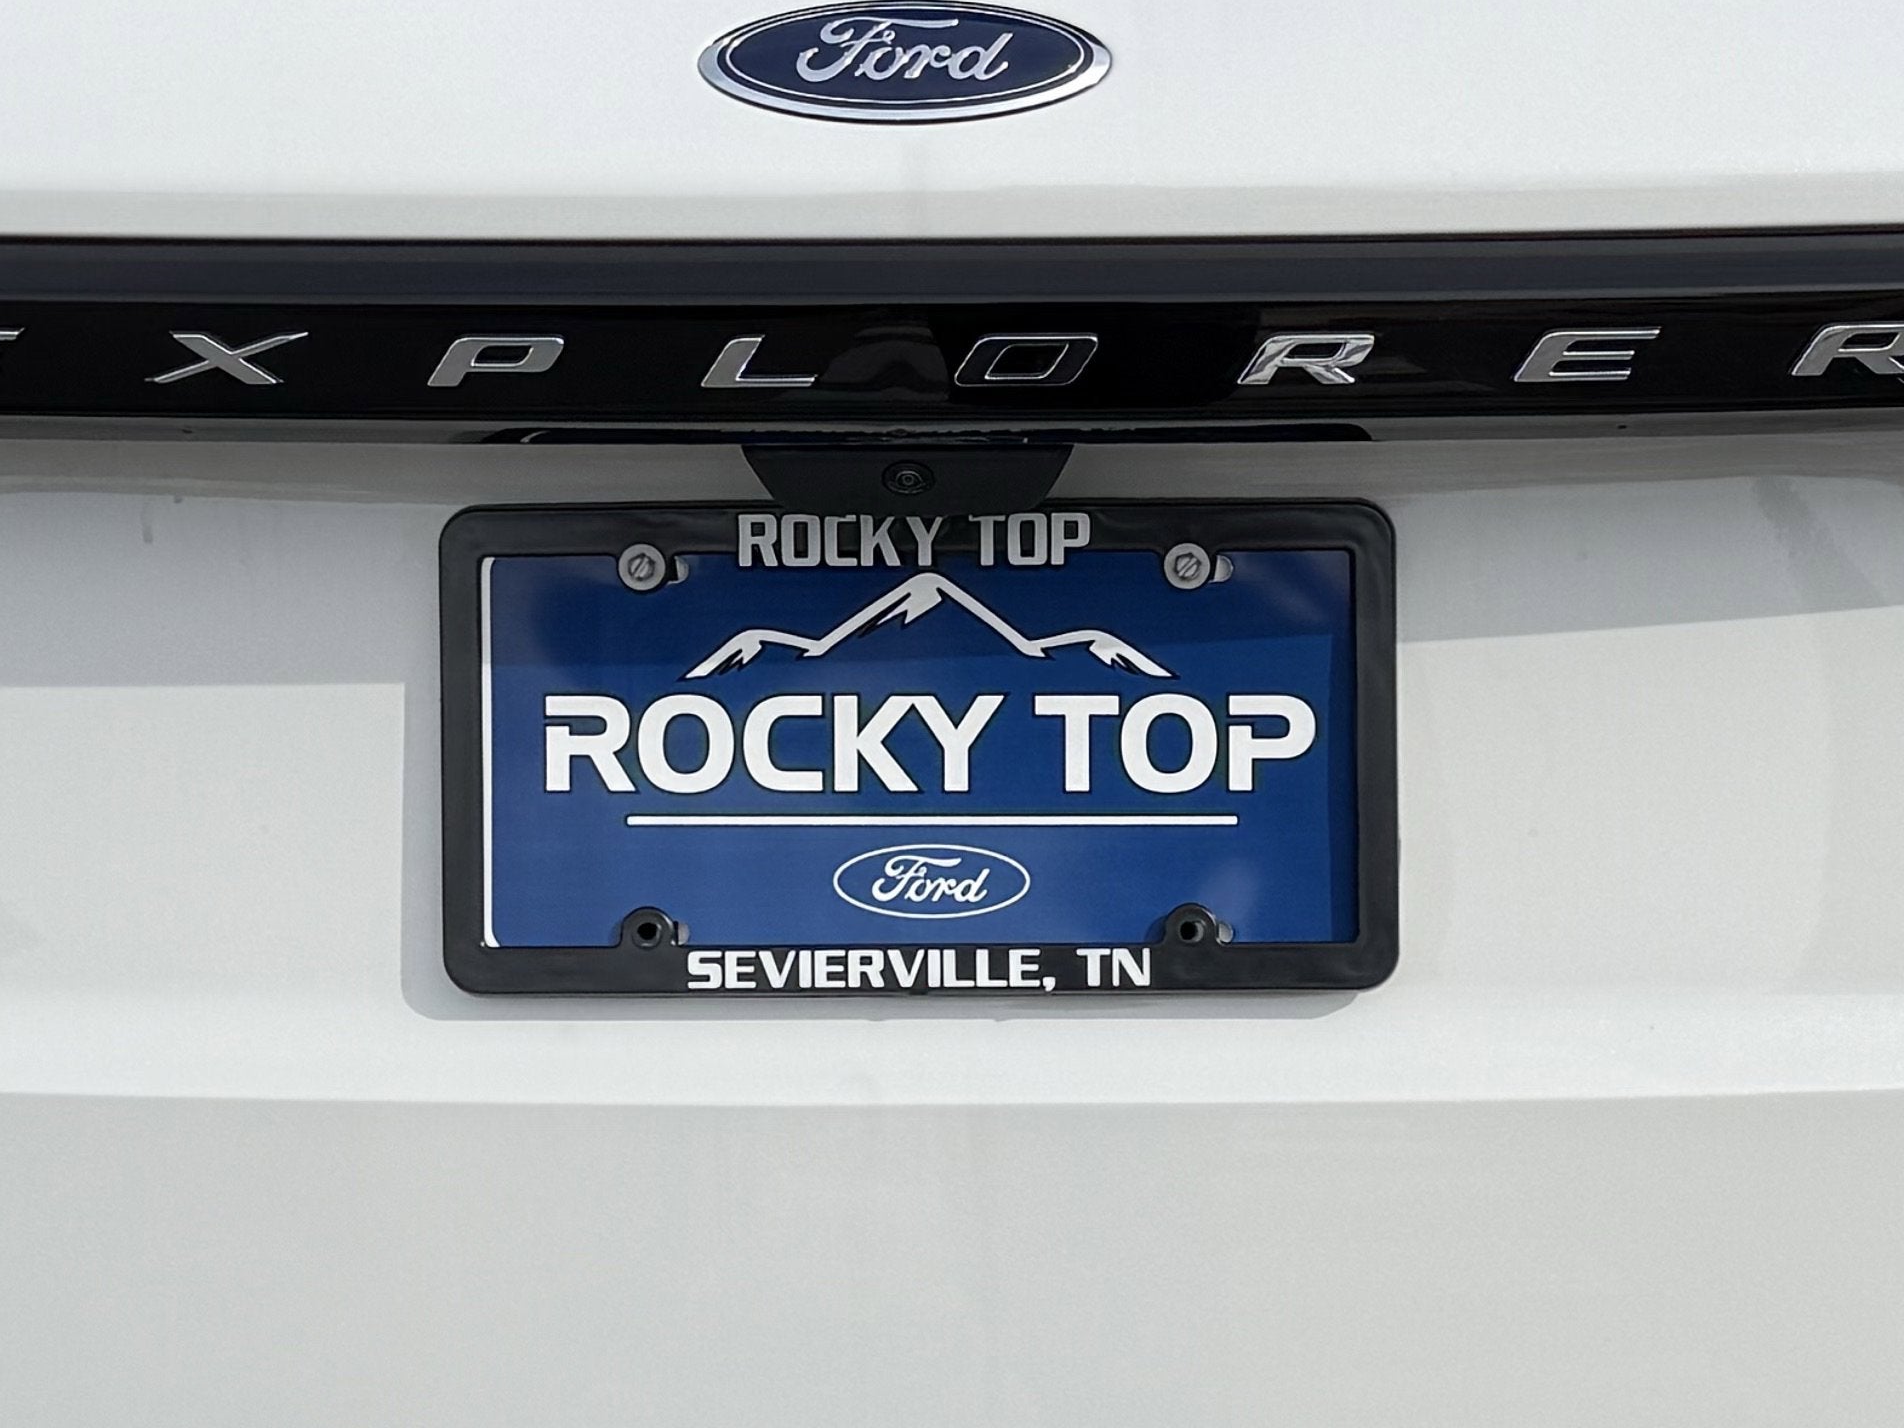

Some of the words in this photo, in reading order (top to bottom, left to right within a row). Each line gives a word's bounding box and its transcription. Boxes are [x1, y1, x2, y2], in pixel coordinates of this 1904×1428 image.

[796, 15, 1013, 83] Ford
[738, 513, 944, 567] ROCKY
[968, 512, 1091, 567] TOP
[544, 694, 1005, 794] ROCKY
[1034, 693, 1317, 793] TOP
[871, 854, 991, 903] Ford
[686, 948, 1056, 992] SEVIERVILLE,
[1076, 947, 1152, 987] TN
